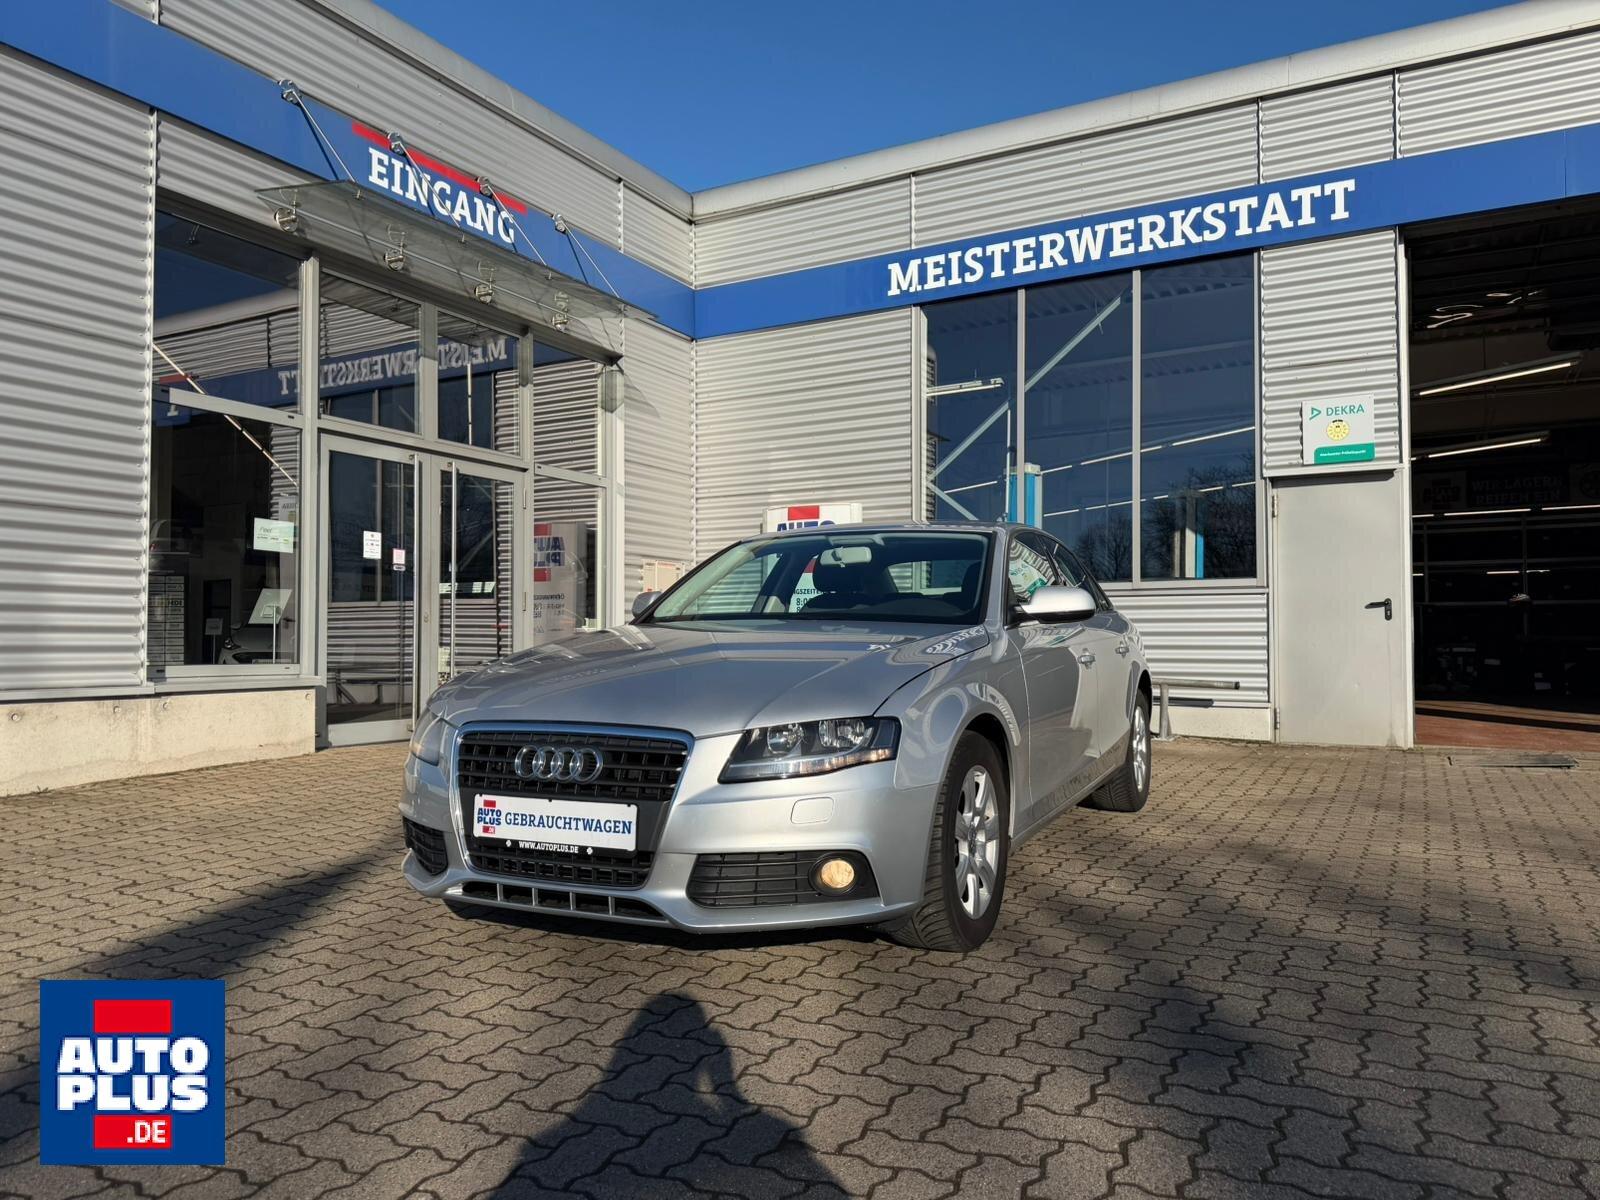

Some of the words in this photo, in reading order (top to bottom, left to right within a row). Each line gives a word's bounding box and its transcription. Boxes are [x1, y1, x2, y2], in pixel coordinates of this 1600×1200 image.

[368, 147, 515, 244] EINGANG
[887, 178, 1356, 297] MEISTERWERKSTATT
[1326, 404, 1365, 416] DEKRA
[477, 807, 502, 818] AUTO
[477, 816, 502, 826] PLUS
[504, 812, 633, 834] GEBRAUCHTWAGEN
[518, 841, 579, 854] WWW.AUTOPLUS.DE
